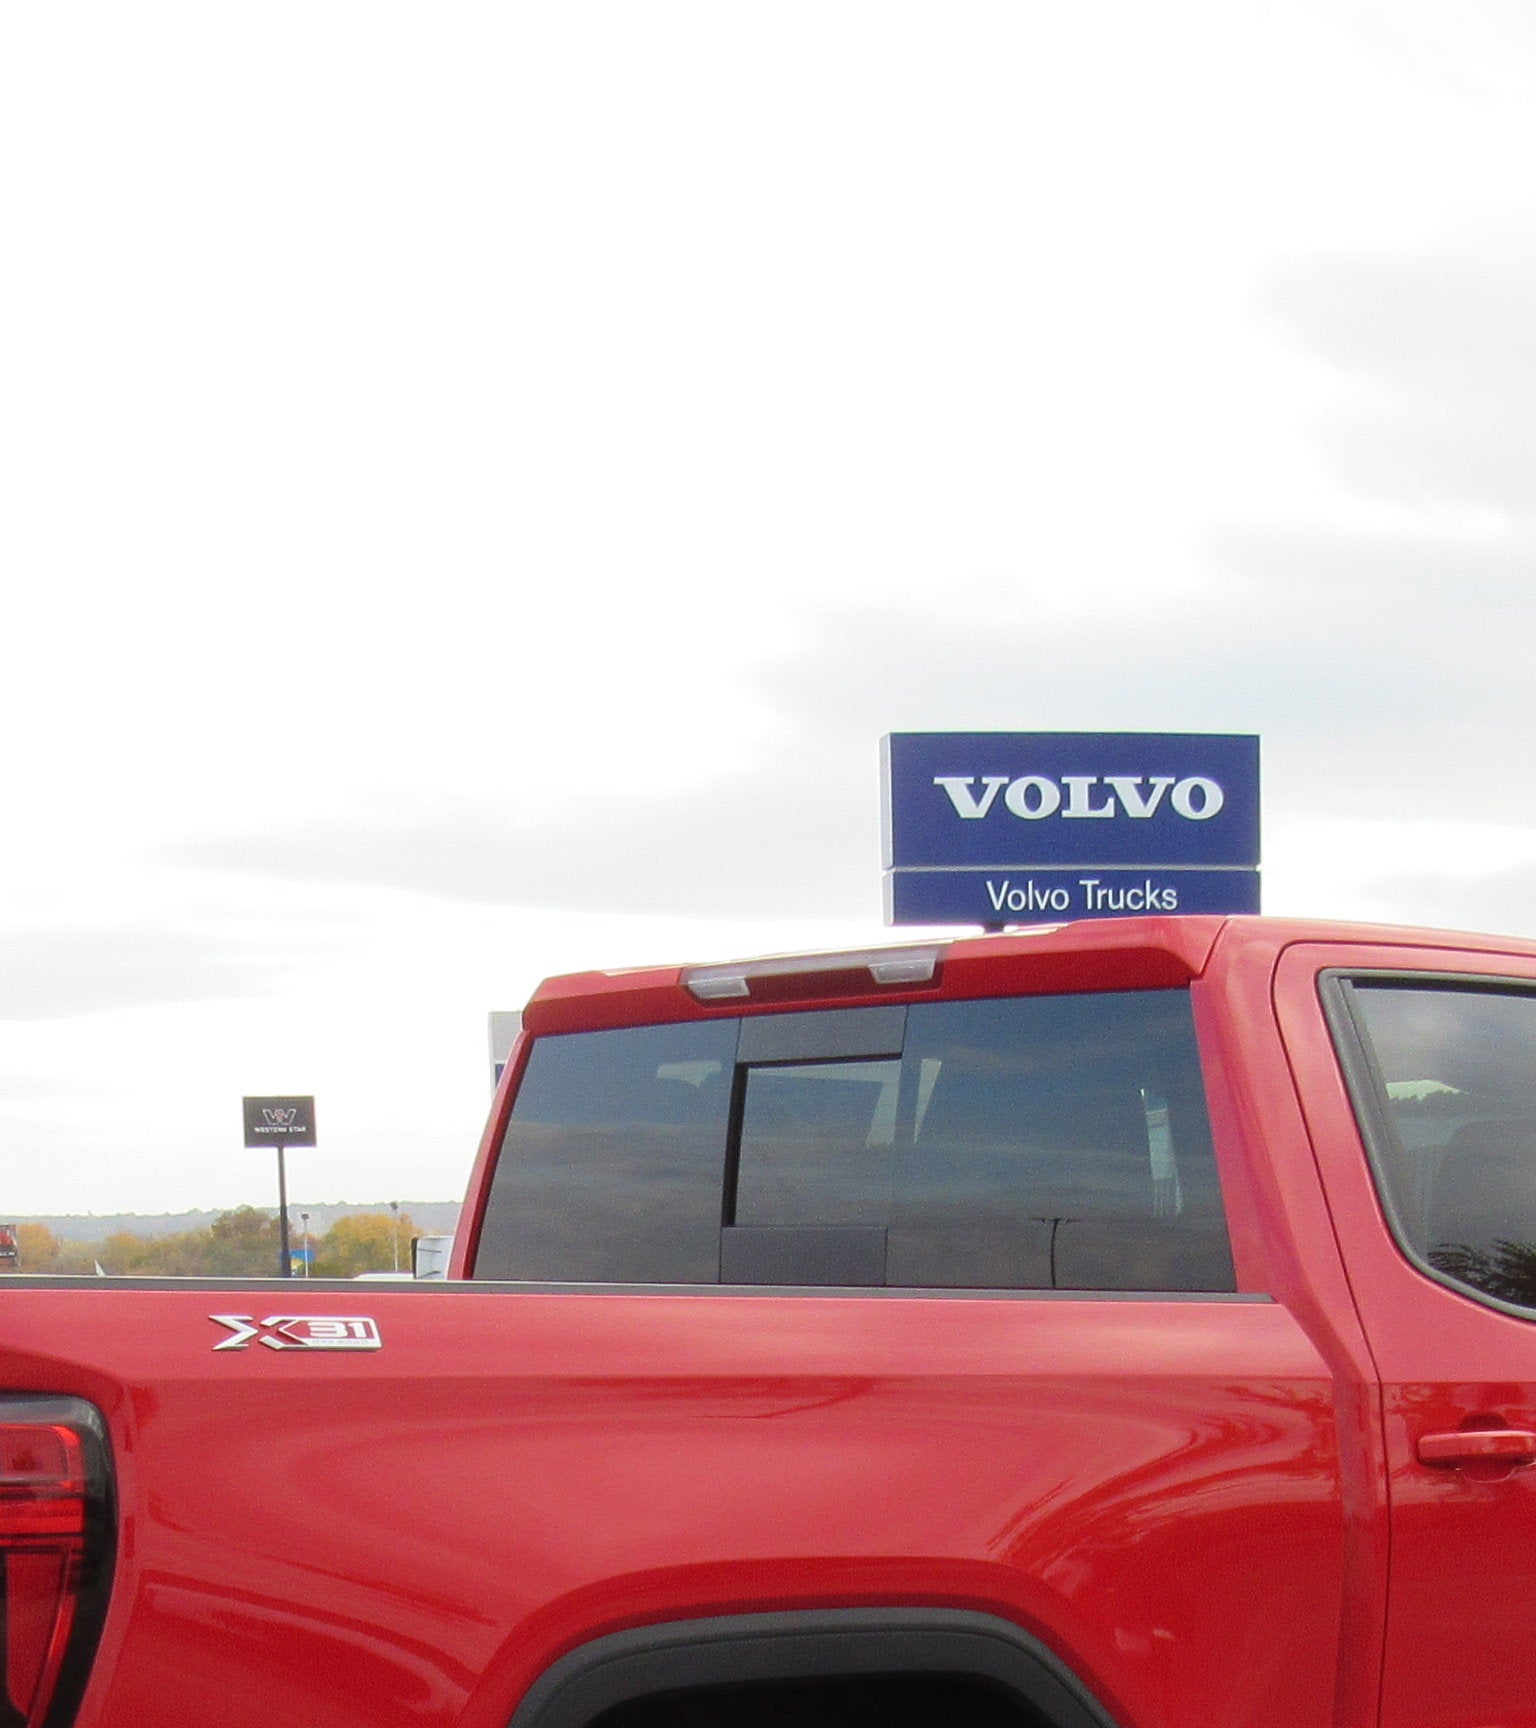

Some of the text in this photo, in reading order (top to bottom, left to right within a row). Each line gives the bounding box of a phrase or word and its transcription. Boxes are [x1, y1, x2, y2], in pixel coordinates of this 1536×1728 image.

[933, 776, 1224, 820] VOLVO
[986, 879, 1178, 911] Volvo Trucks
